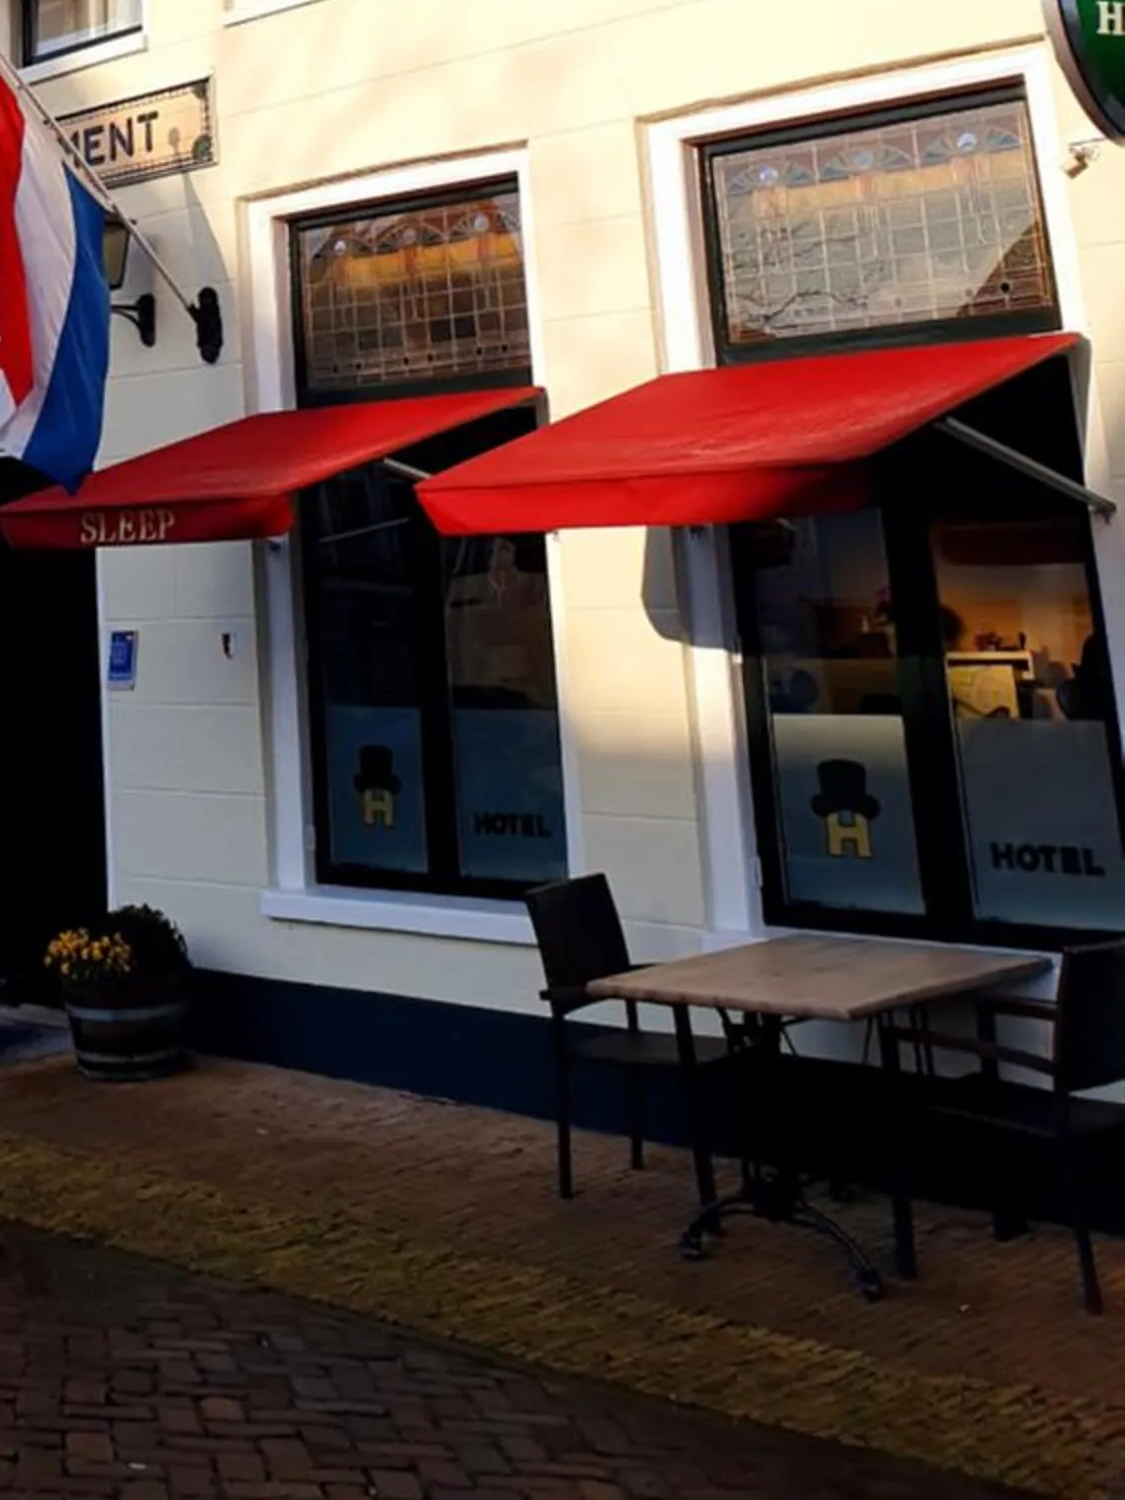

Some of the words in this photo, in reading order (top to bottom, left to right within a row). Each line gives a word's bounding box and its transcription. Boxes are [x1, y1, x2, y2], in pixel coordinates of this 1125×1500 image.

[80, 510, 175, 543] SLEEP
[475, 813, 552, 838] HOTEL
[989, 841, 1106, 877] HOTEL
